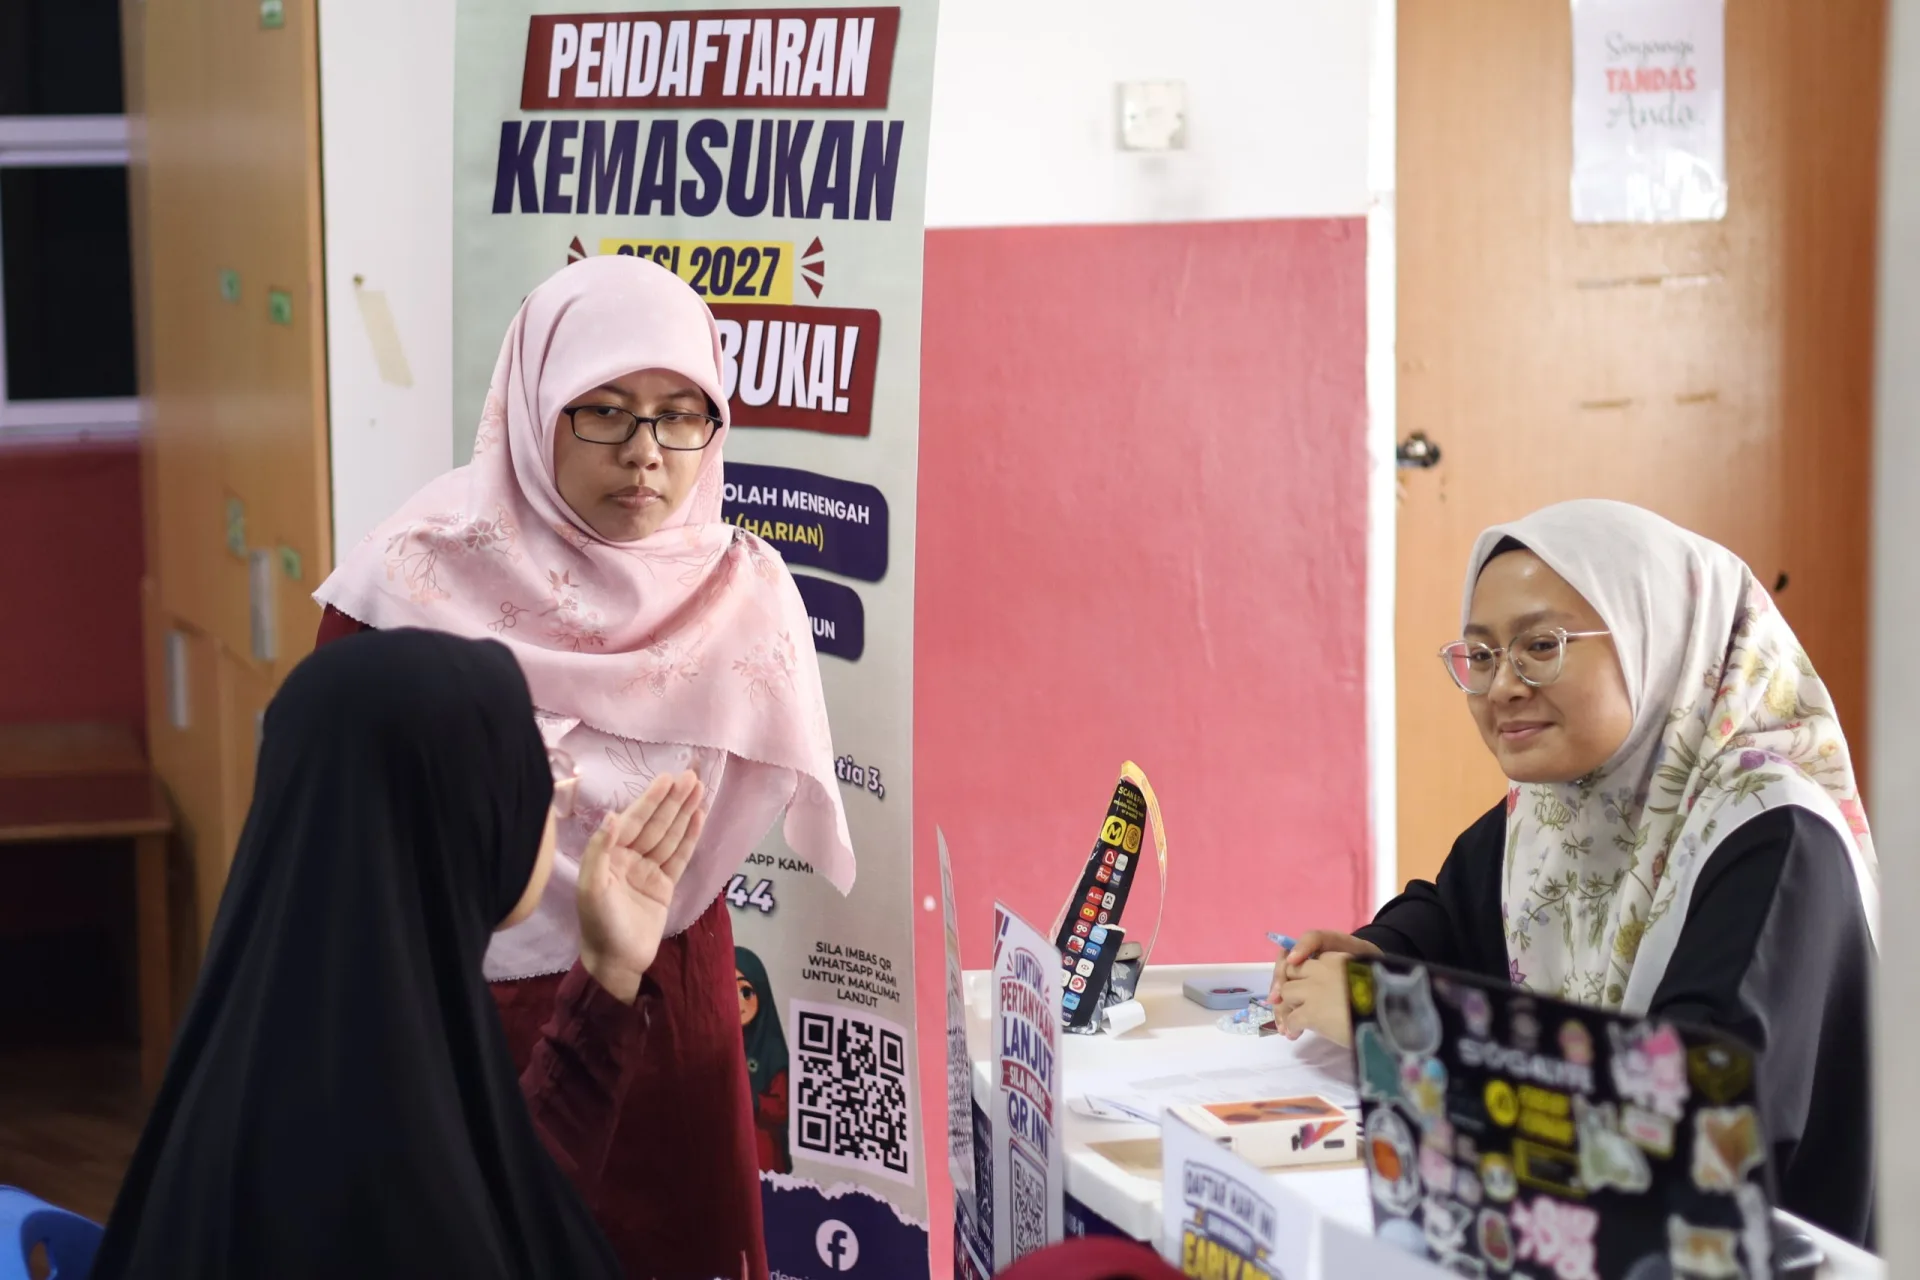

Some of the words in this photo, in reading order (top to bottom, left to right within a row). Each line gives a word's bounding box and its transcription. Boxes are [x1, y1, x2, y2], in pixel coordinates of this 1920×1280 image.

[546, 17, 876, 99] PENDAFTARAN
[1604, 67, 1696, 94] TANDAS
[491, 118, 905, 222] KEMASUKAN
[688, 245, 781, 297] 2027
[782, 488, 870, 526] MENENGAH
[867, 766, 885, 799] 3,
[745, 852, 775, 867] APP
[808, 954, 873, 978] WHATSAPP
[875, 970, 897, 988] KAMI
[815, 941, 843, 957] SILA
[845, 946, 878, 966] IMBAS
[879, 956, 893, 972] QR
[802, 968, 846, 986] UNTUK
[848, 976, 901, 1004] MAKLUMAT
[1015, 952, 1043, 999] UNTUK
[837, 988, 878, 1009] LANJUT
[1003, 1016, 1053, 1093] LANJUT
[1008, 1090, 1028, 1137] QR
[1031, 1107, 1048, 1160] INI
